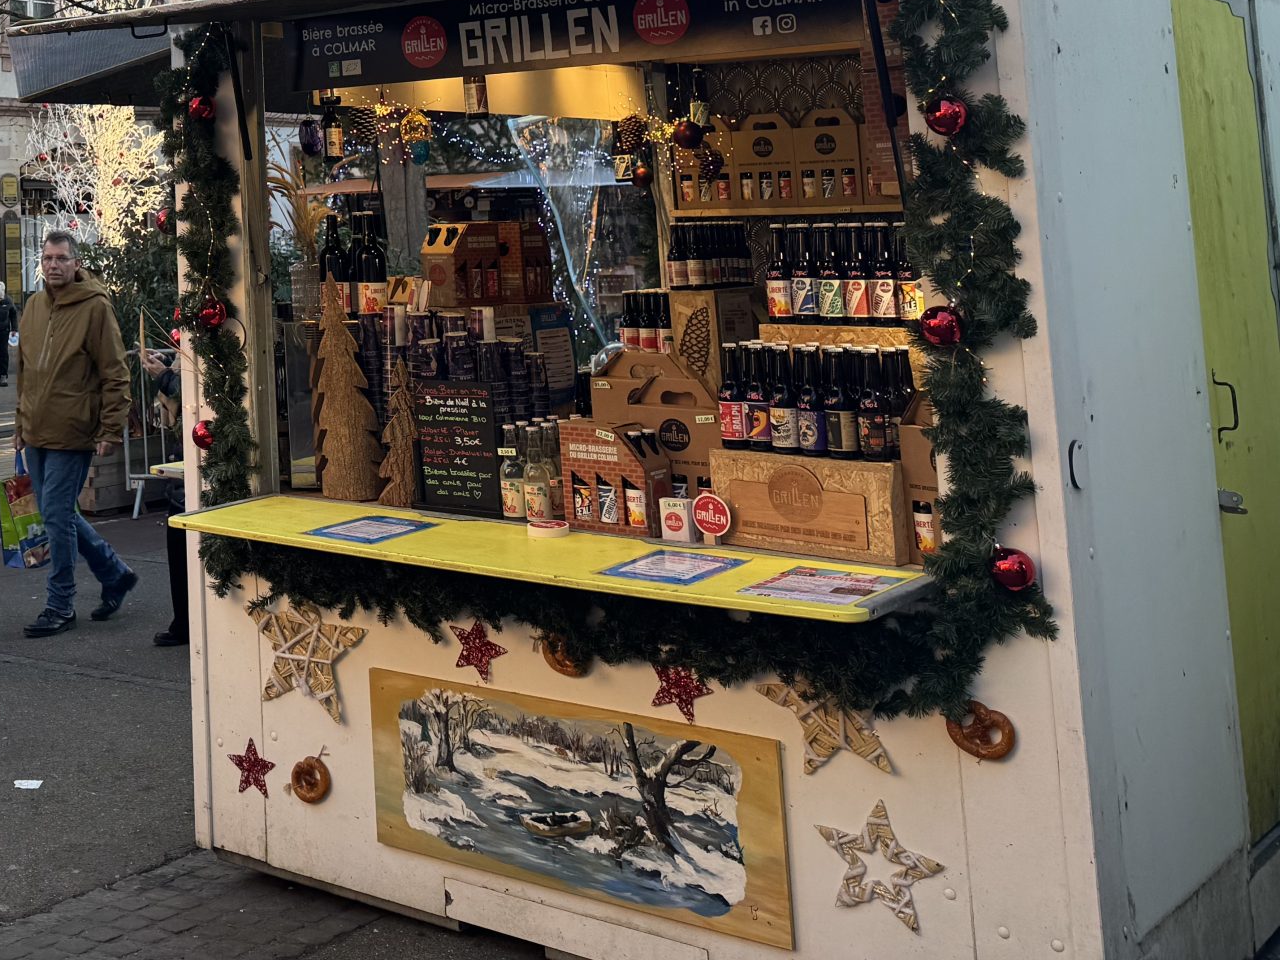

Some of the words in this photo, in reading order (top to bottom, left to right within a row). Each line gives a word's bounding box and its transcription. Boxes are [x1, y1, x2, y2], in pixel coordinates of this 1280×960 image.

[637, 7, 687, 29] GRILLEN
[302, 26, 333, 41] Bière
[336, 20, 384, 38] brassée
[458, 5, 620, 67] GRILLEN
[311, 43, 321, 57] à
[323, 39, 377, 56] COLMAR
[404, 34, 445, 54] GRILLEN
[471, 415, 487, 423] BIO
[732, 404, 741, 432] RALPH
[569, 443, 618, 454] MICRO-BRASSERIE
[577, 452, 598, 460] GRILLEN
[597, 453, 618, 461] COLMAR
[453, 457, 469, 466] 4€
[773, 488, 819, 508] GRILLEN
[696, 508, 727, 525] GRILLEN
